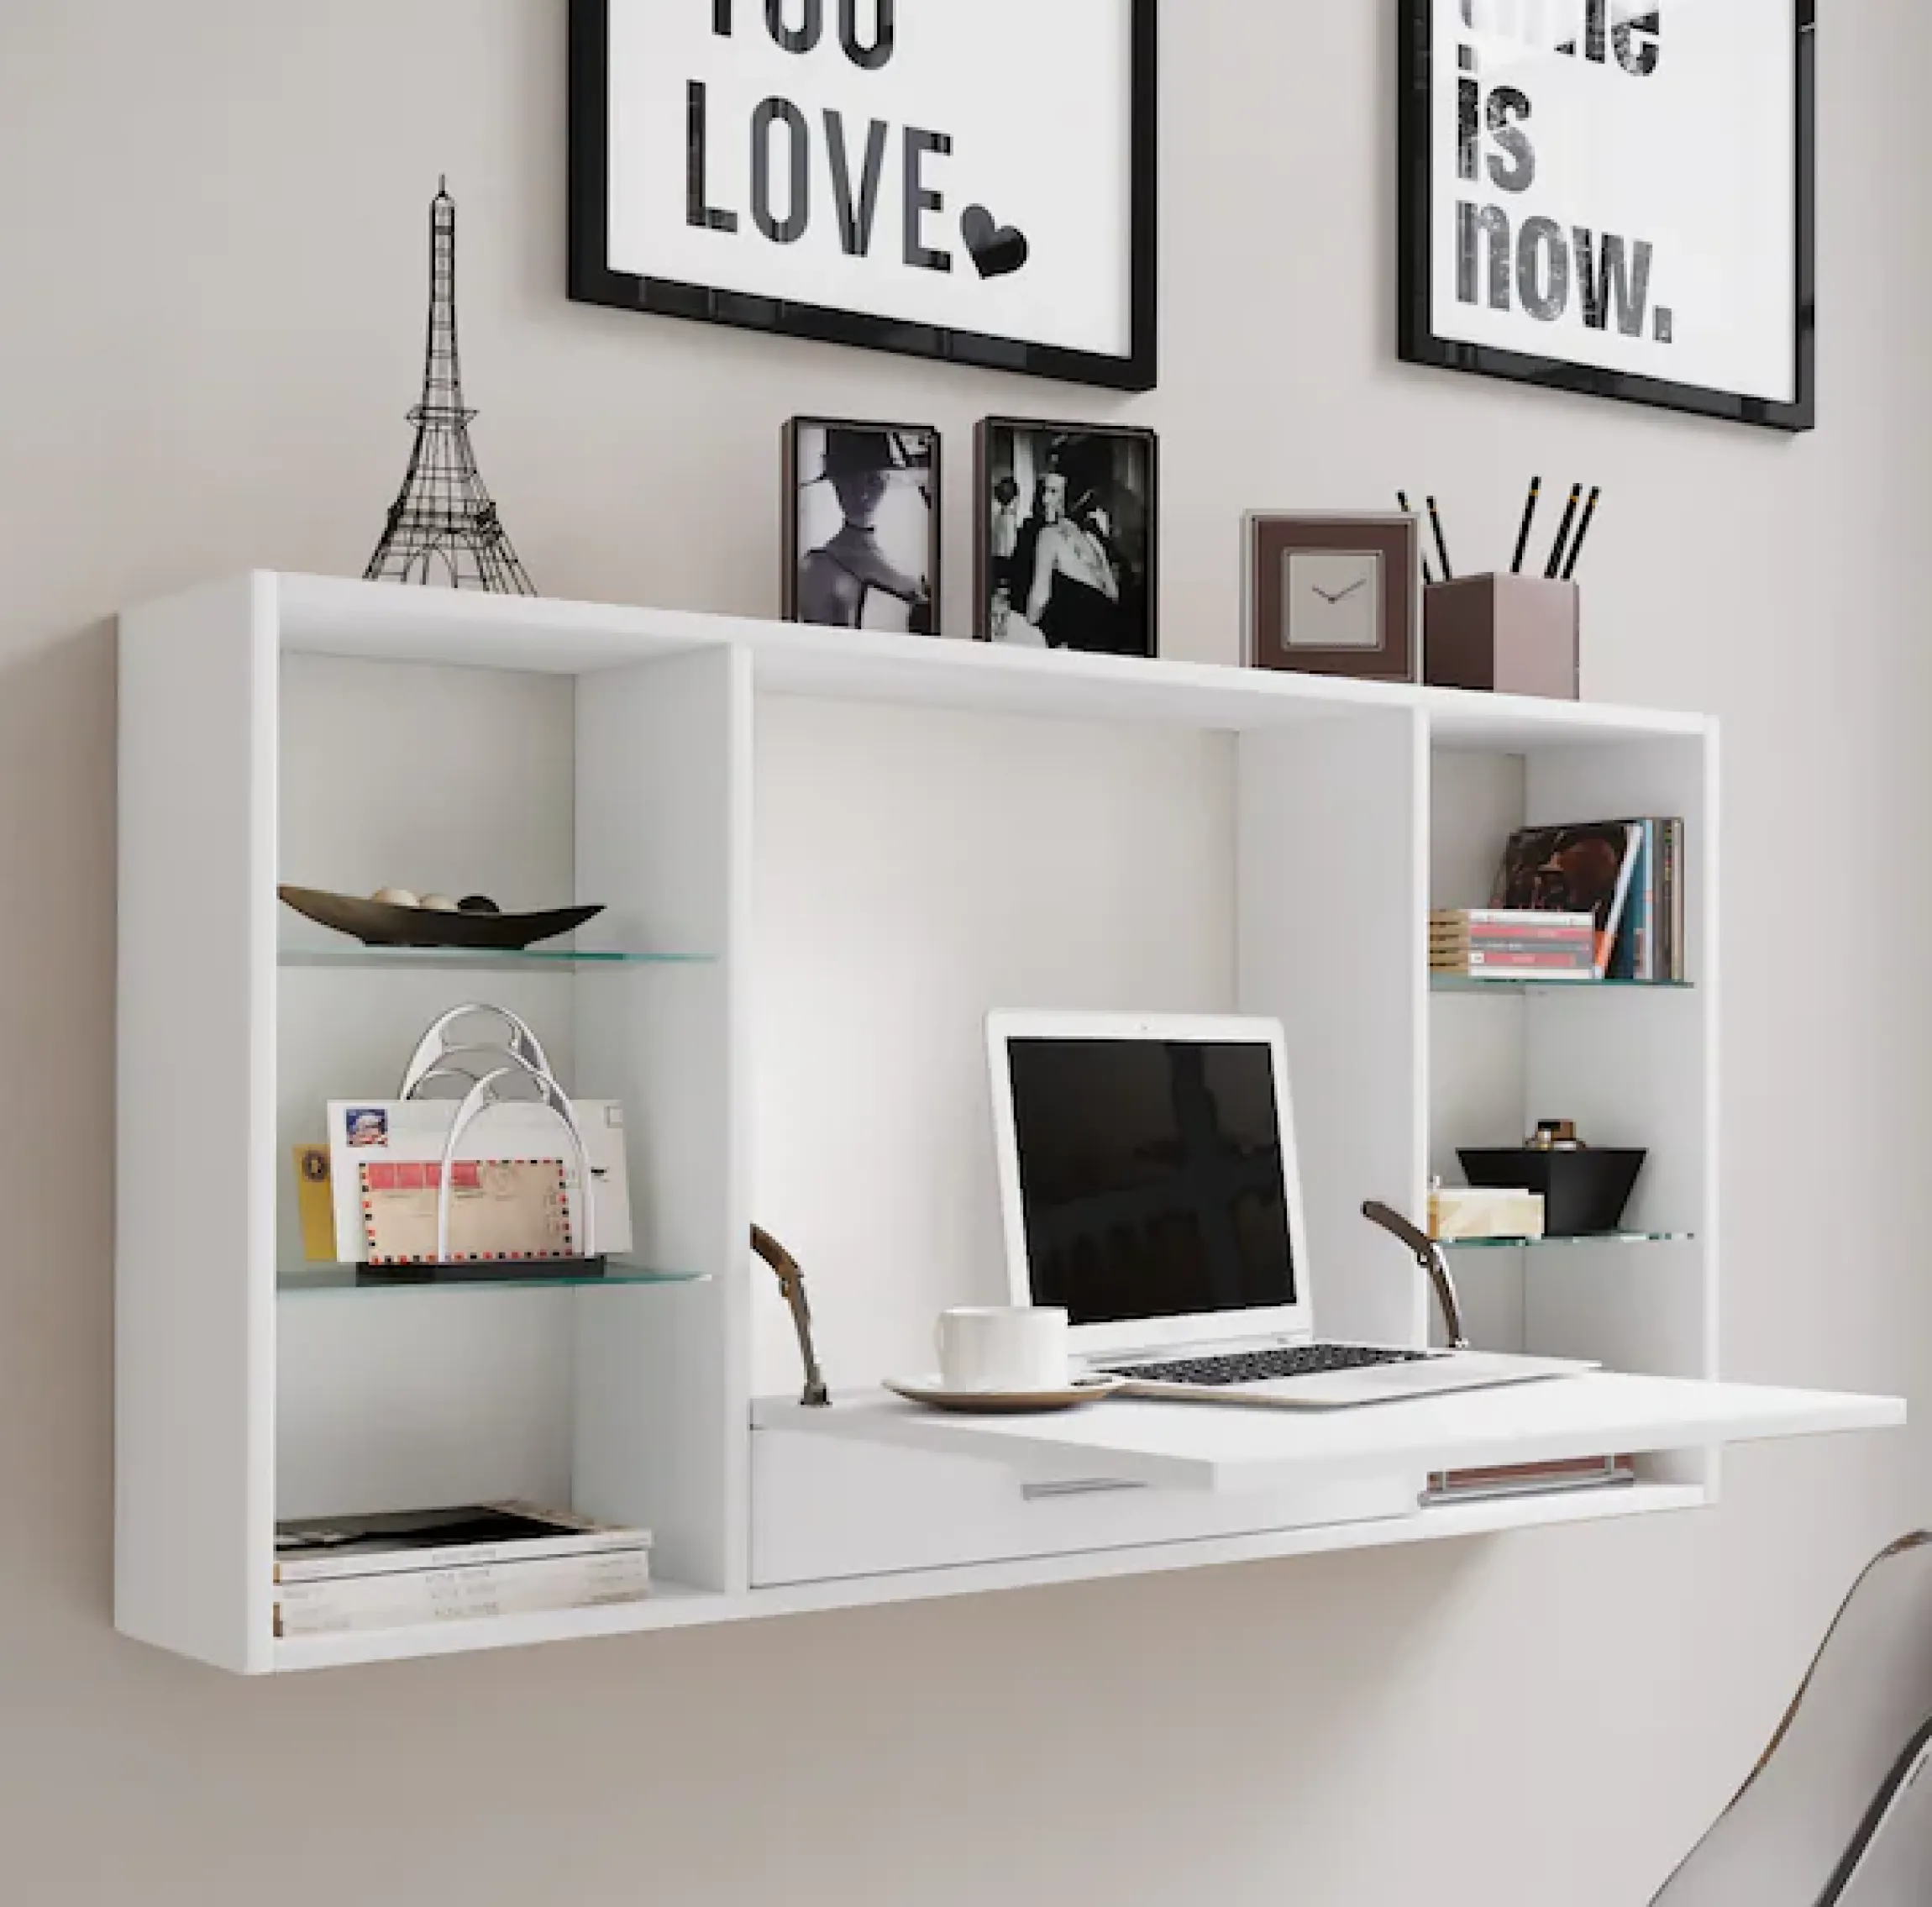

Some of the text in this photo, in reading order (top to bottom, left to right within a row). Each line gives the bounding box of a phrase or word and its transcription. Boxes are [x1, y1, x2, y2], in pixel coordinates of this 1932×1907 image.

[685, 79, 953, 273] LOVE
[1457, 44, 1536, 193] is
[1456, 199, 1672, 344] now.
